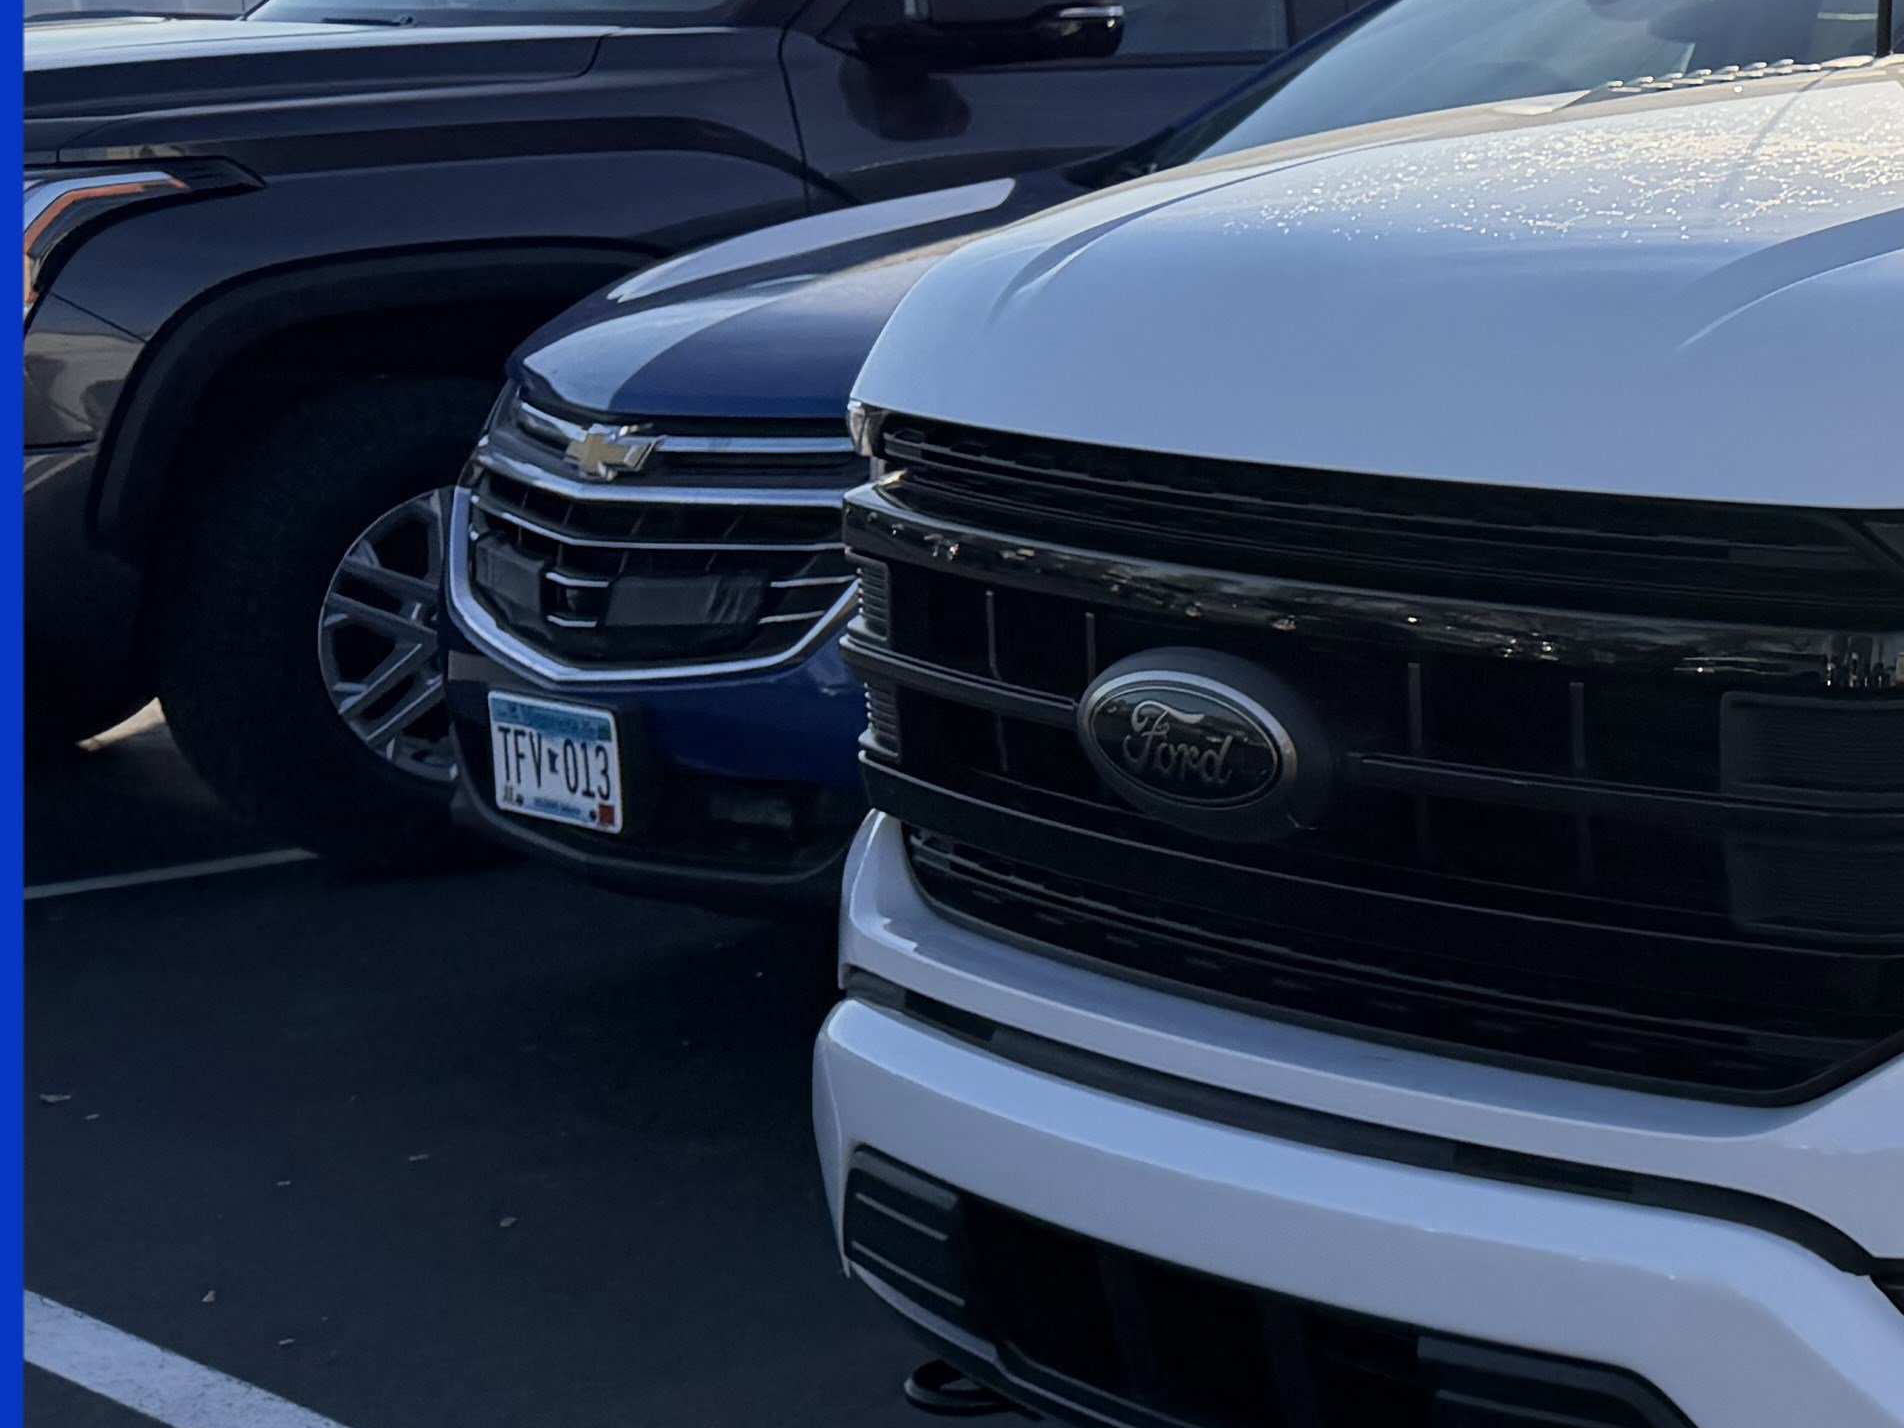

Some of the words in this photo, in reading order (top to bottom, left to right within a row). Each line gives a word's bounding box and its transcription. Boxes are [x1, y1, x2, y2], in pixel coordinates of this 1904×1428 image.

[498, 725, 542, 789] TFV
[562, 737, 611, 801] 013
[1122, 700, 1234, 785] Ford
